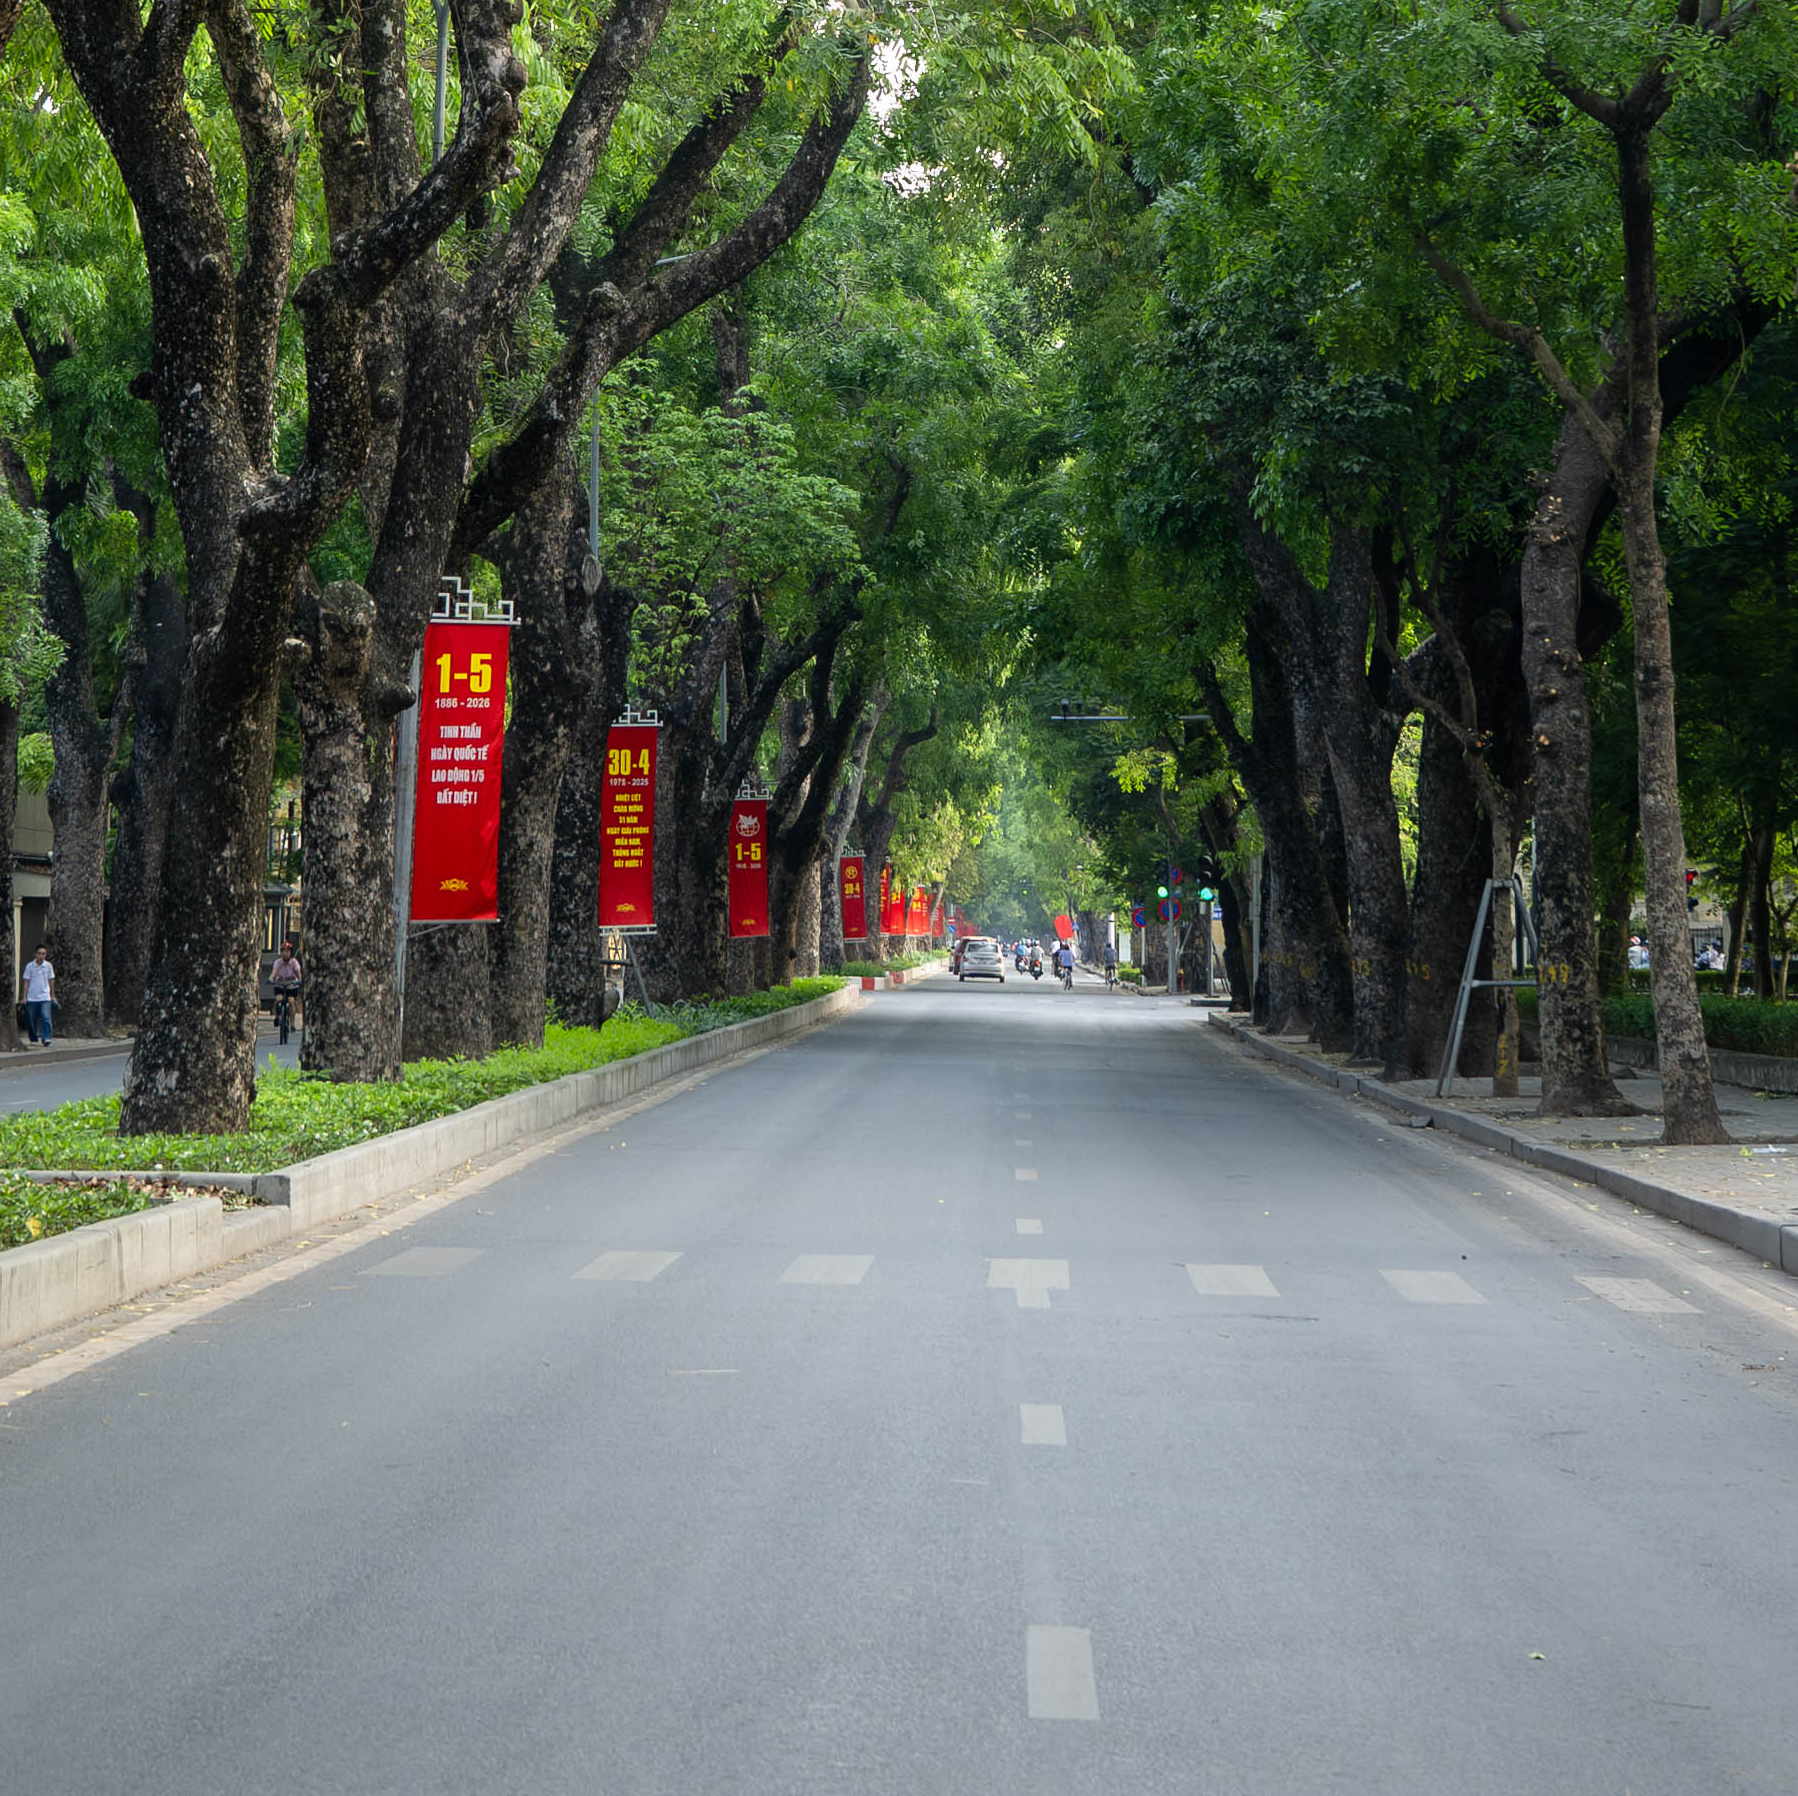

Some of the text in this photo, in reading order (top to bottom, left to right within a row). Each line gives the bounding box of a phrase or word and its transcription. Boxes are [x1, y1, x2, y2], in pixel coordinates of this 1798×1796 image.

[436, 653, 492, 693] 1-5
[466, 697, 491, 709] 2026
[608, 749, 650, 775] 30-4
[735, 843, 761, 861] 1-5
